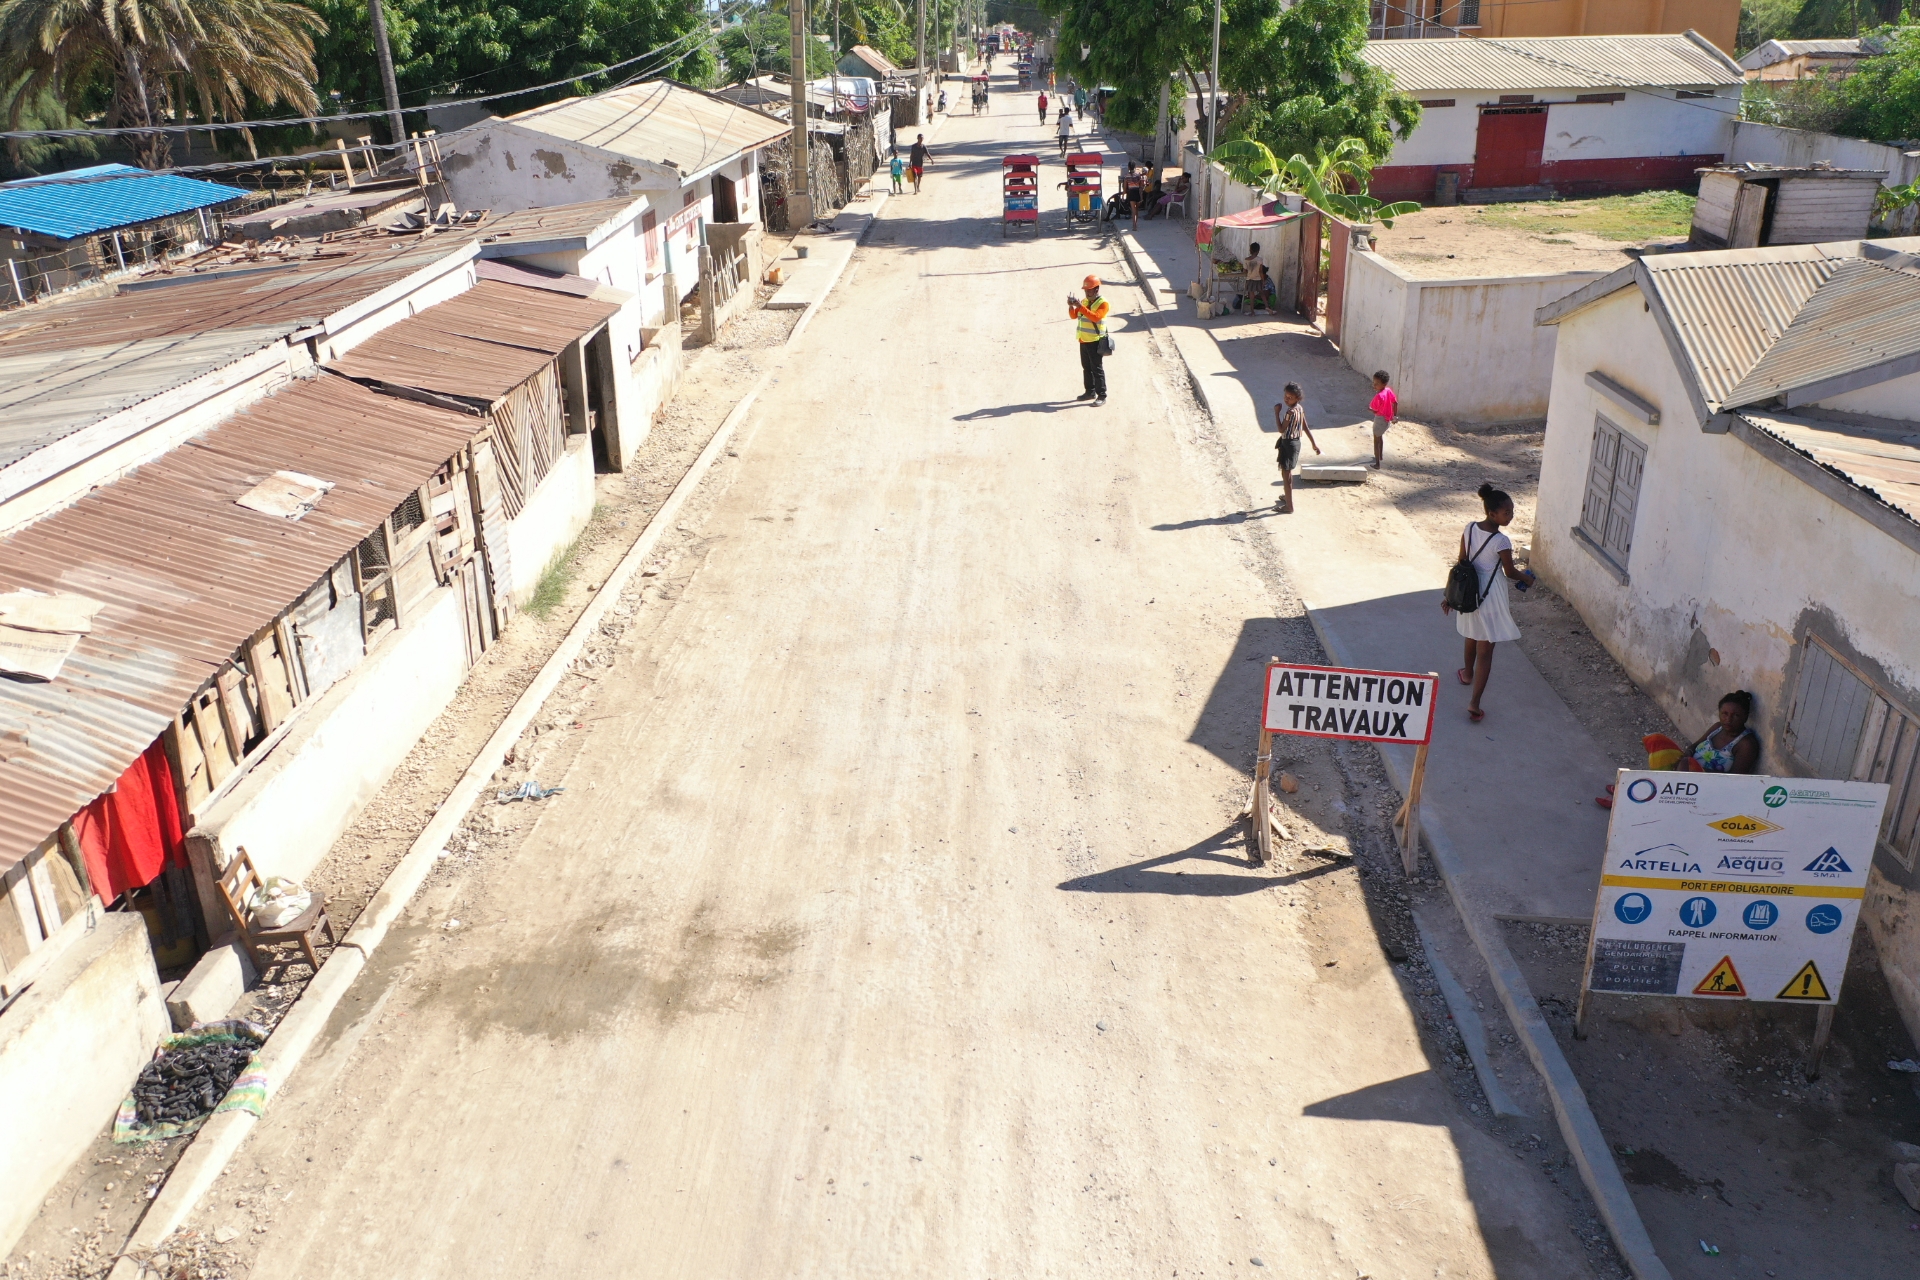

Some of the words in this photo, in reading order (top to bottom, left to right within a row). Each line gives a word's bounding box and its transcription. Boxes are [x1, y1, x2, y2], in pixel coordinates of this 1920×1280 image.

[1276, 672, 1425, 706] ATTENTION
[1289, 704, 1409, 737] TRAVAUX
[1661, 782, 1699, 796] AFD
[1721, 822, 1756, 830] COLAS
[1620, 859, 1702, 873] ARTELIA
[1717, 855, 1783, 873] Aequo
[1681, 881, 1708, 891] PORT
[1710, 883, 1728, 892] EPI
[1729, 883, 1794, 895] OBLIGATOIRE
[1668, 929, 1707, 939] RAPPEL
[1709, 931, 1777, 942] INFORMATION
[1634, 943, 1672, 951] URGENCE
[1613, 964, 1656, 972] POLICE
[1606, 976, 1660, 984] POMPIER
